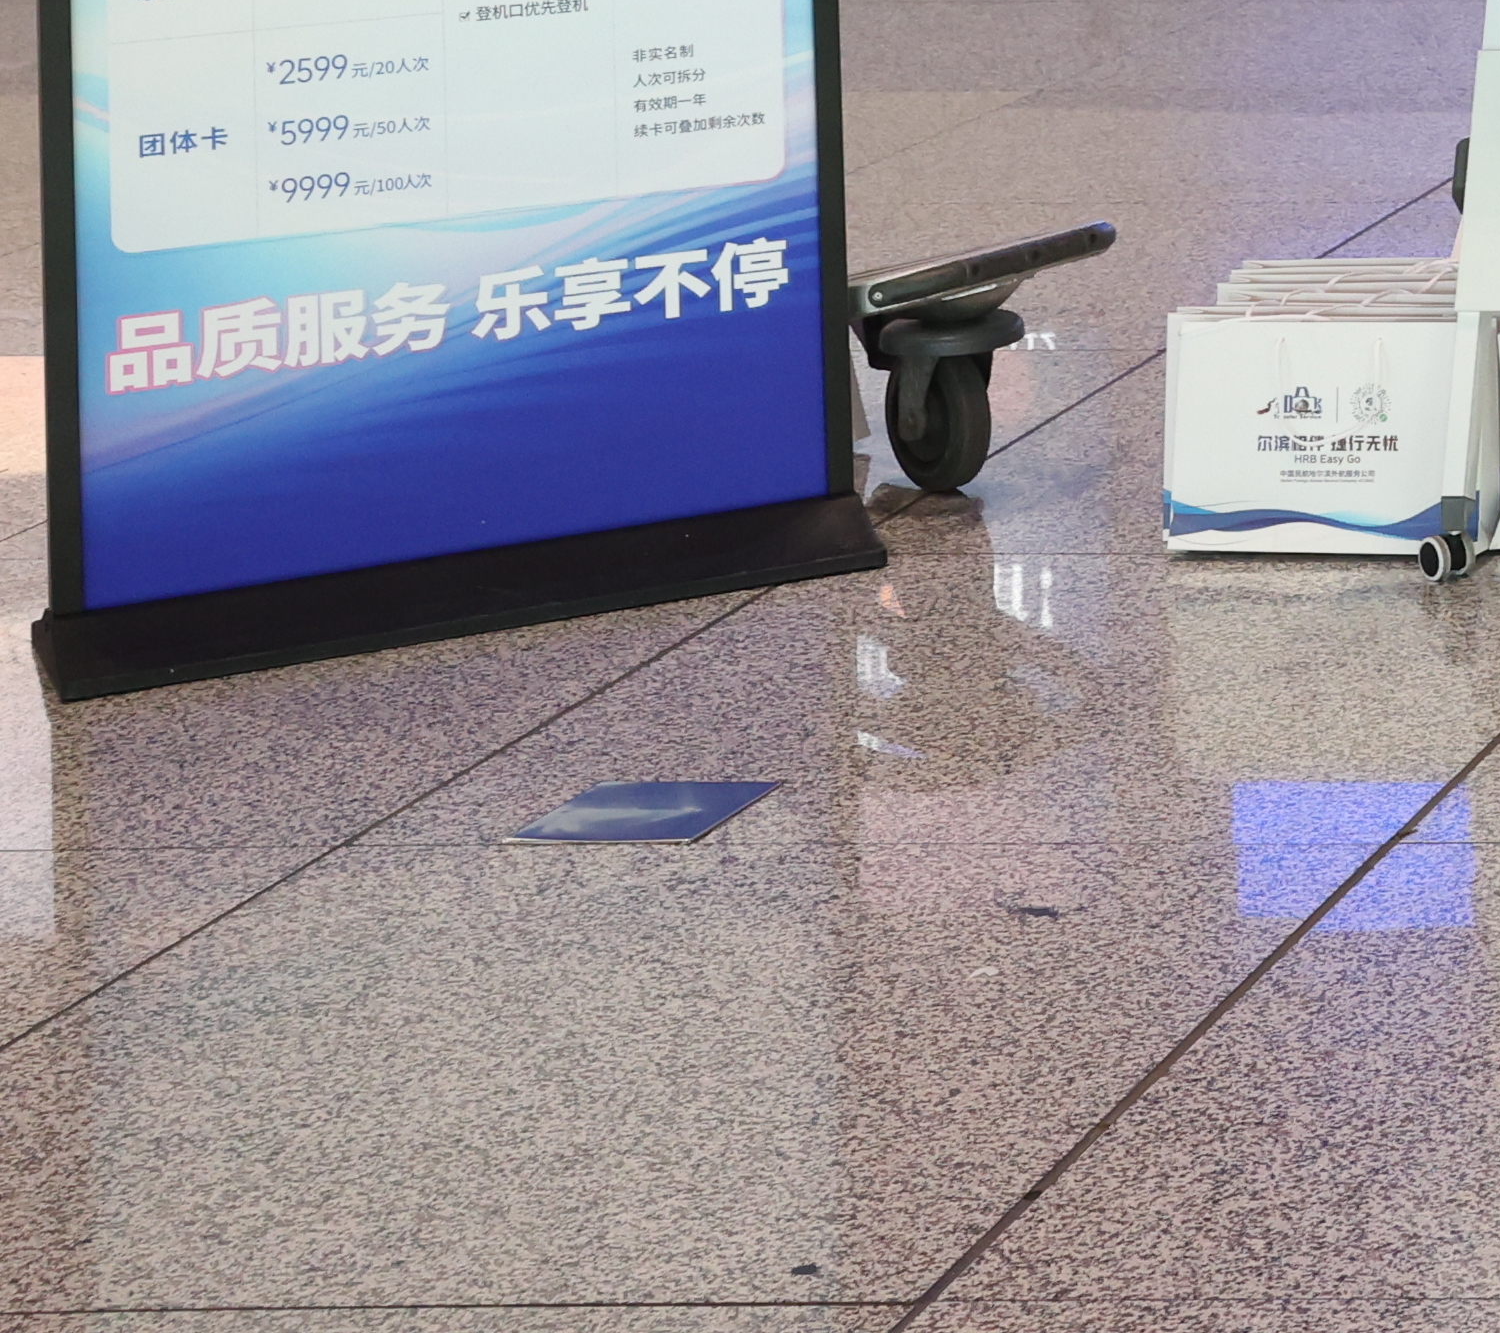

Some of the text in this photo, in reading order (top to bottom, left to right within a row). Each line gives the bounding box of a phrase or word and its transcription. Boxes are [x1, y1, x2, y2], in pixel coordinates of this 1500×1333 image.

[137, 124, 230, 159] 团体卡
[106, 235, 792, 396] 品质服务 乐享不停
